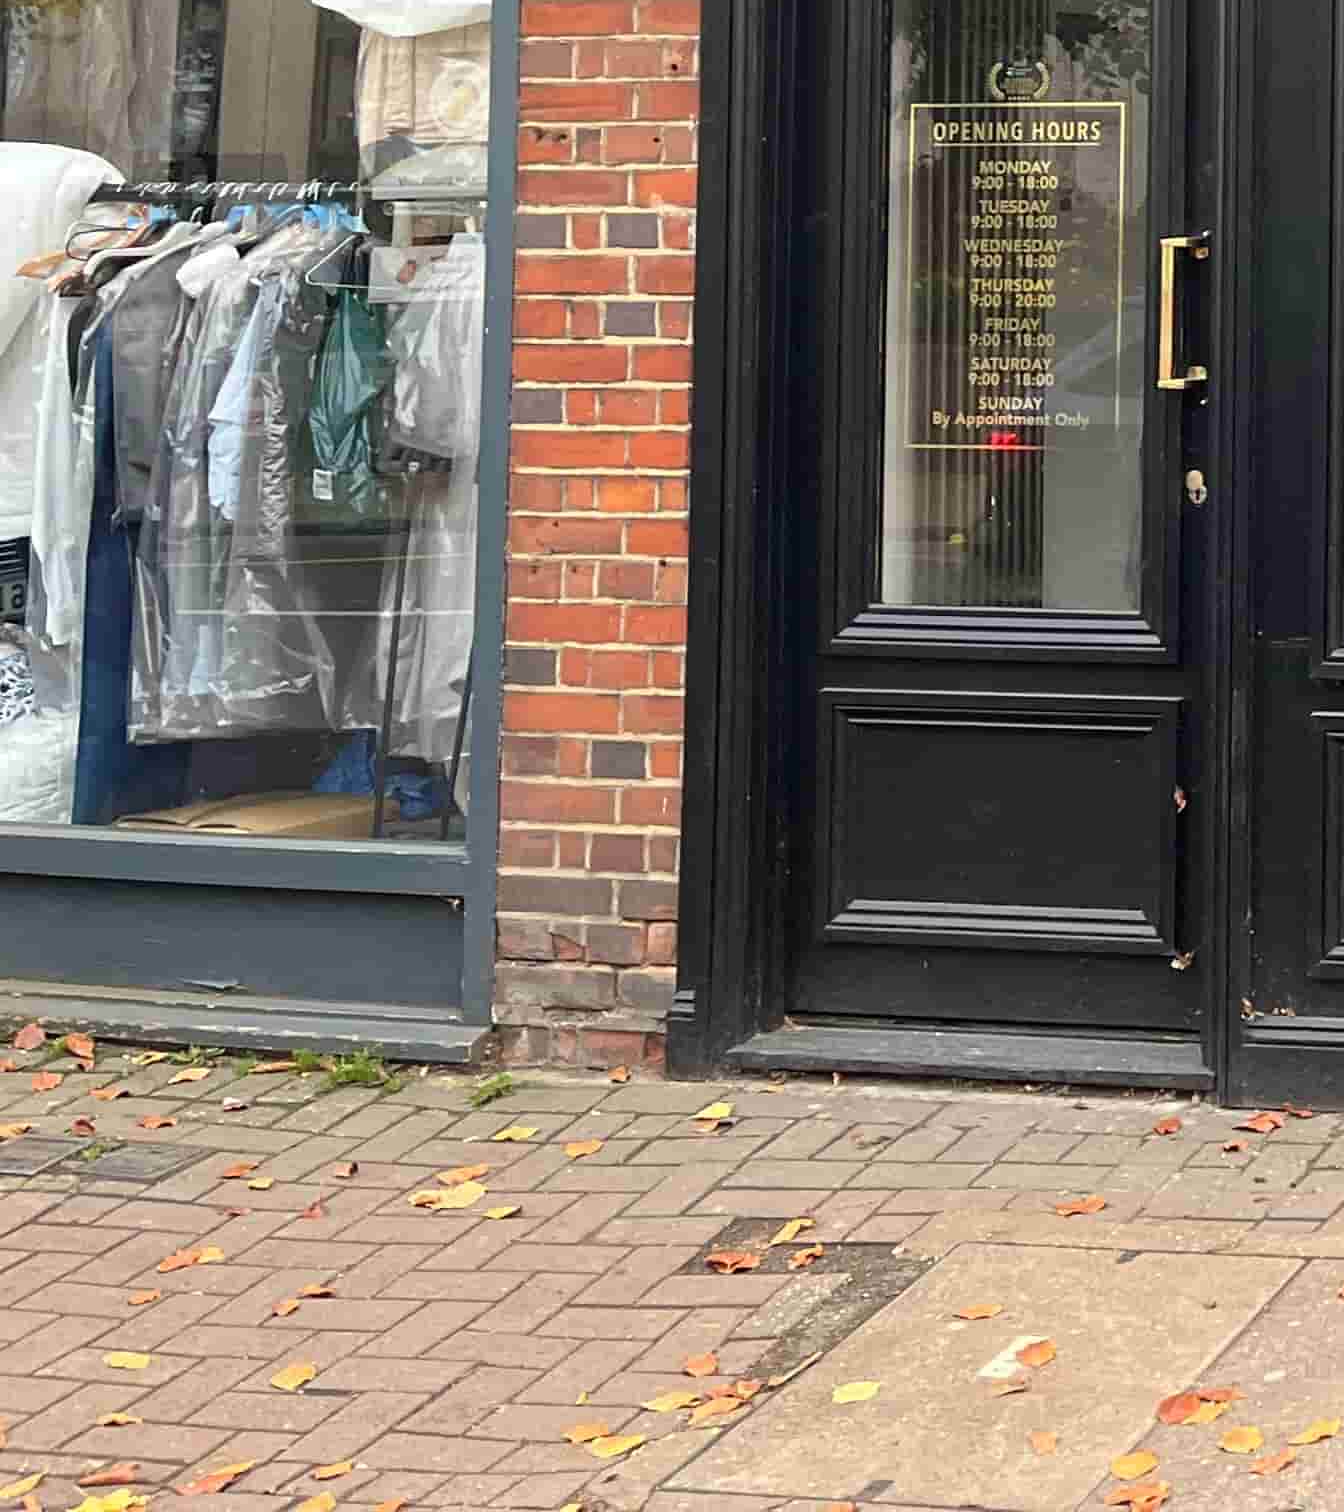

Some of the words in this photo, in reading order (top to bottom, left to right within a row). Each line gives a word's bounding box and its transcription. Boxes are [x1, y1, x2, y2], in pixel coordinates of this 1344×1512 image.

[933, 121, 1023, 141] OPENING
[1032, 121, 1101, 141] HOURS
[980, 161, 1051, 174] MONDAY
[972, 176, 1003, 189] 9:00
[1020, 176, 1058, 189] 18:00
[980, 200, 1050, 213] TUESDAY
[971, 215, 1002, 228] 9:00
[1018, 215, 1057, 228] 18:00
[964, 239, 1064, 252] WEDNESDAY
[971, 254, 1002, 268] 9:00
[1016, 254, 1056, 268] 18:00
[972, 278, 1055, 291] THURSDAY
[970, 294, 1001, 307] 9:00
[1015, 294, 1056, 307] 20:00
[984, 318, 1040, 331] FRIDAY
[969, 333, 1000, 346] 9:00
[1015, 333, 1055, 346] 18:00
[971, 357, 1051, 371] SATURDAY
[968, 373, 1000, 386] 9:00
[1014, 373, 1054, 386] 18:00
[978, 397, 1043, 410] SUNDAY
[932, 411, 950, 428] By
[955, 411, 1050, 428] Appointment
[1055, 411, 1089, 429] Only
